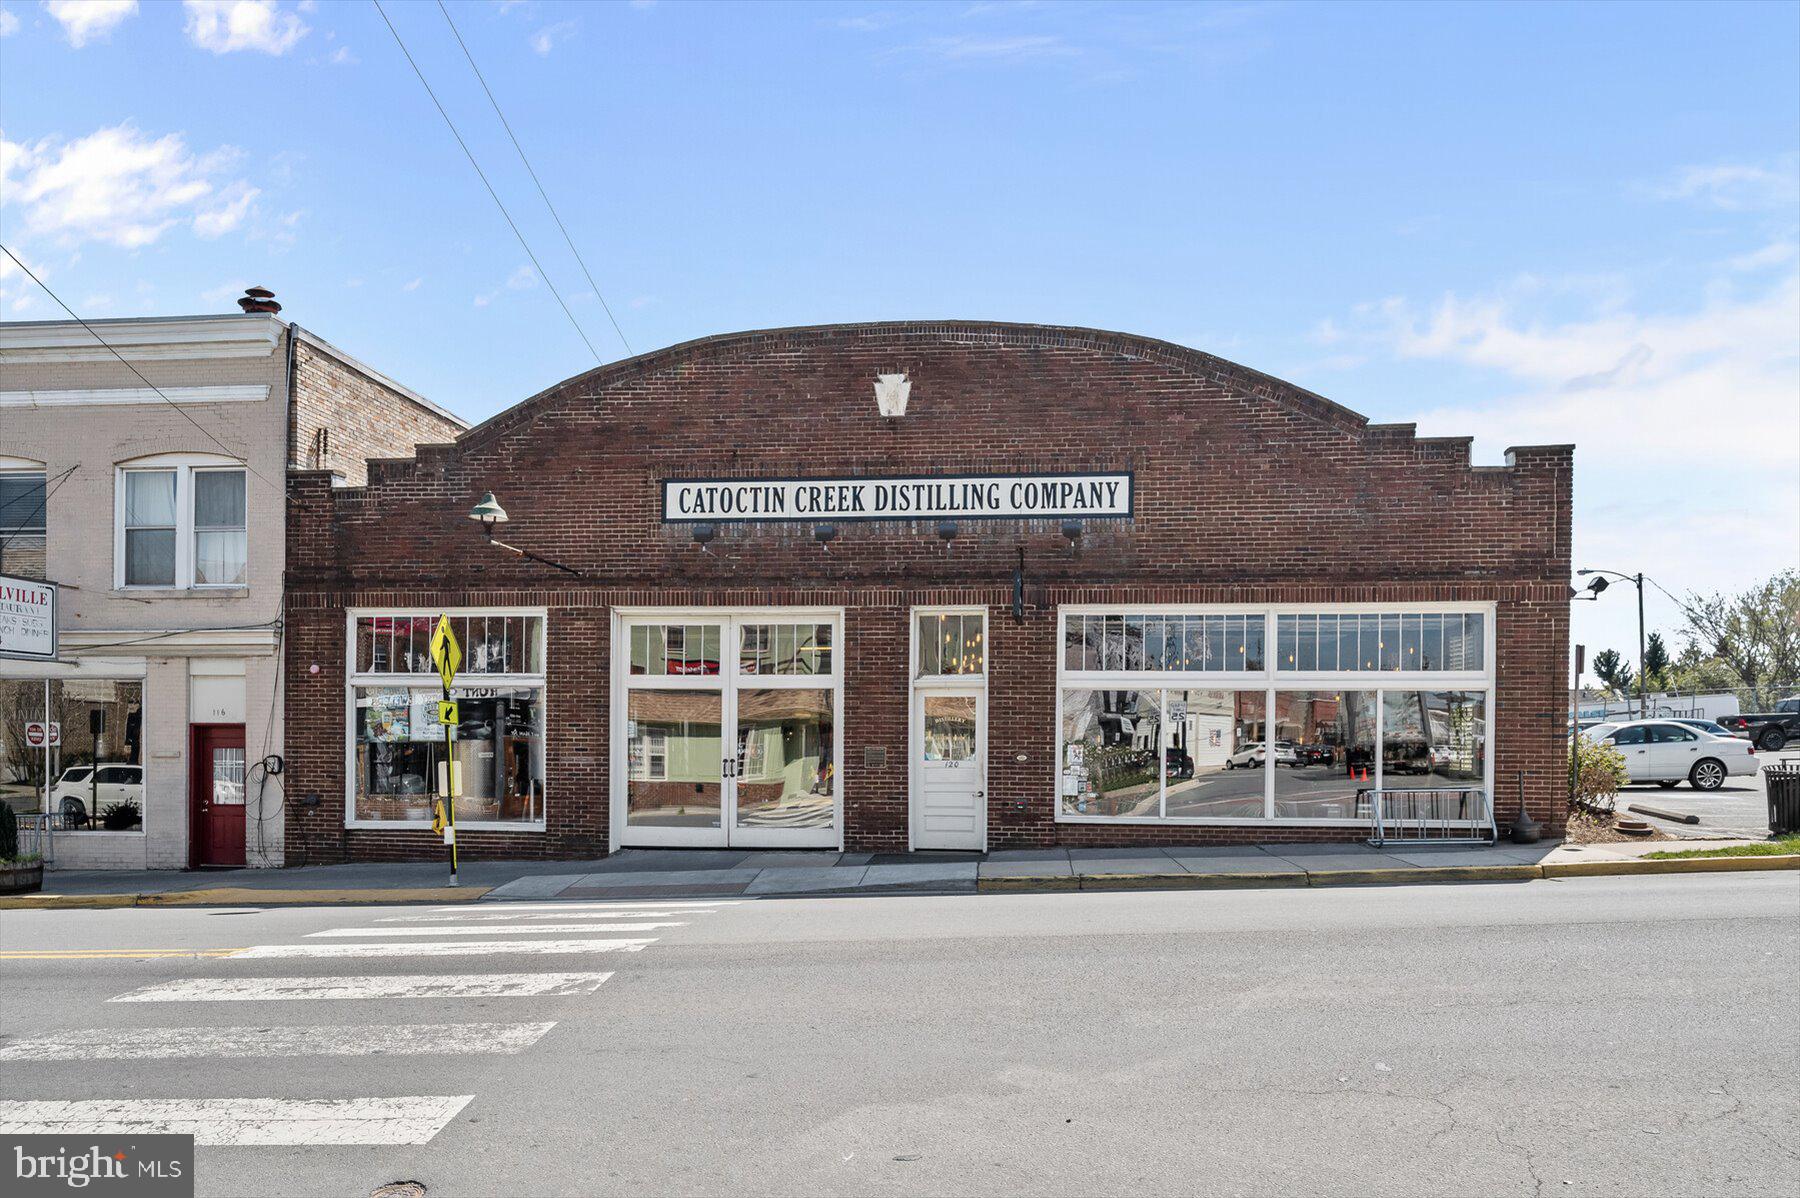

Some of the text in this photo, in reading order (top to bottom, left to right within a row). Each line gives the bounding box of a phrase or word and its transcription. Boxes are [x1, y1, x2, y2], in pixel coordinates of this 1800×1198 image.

[679, 481, 1120, 514] CATOCTIN CREEK DISTILLING COMPANY
[212, 708, 226, 717] 116
[944, 760, 960, 768] 120
